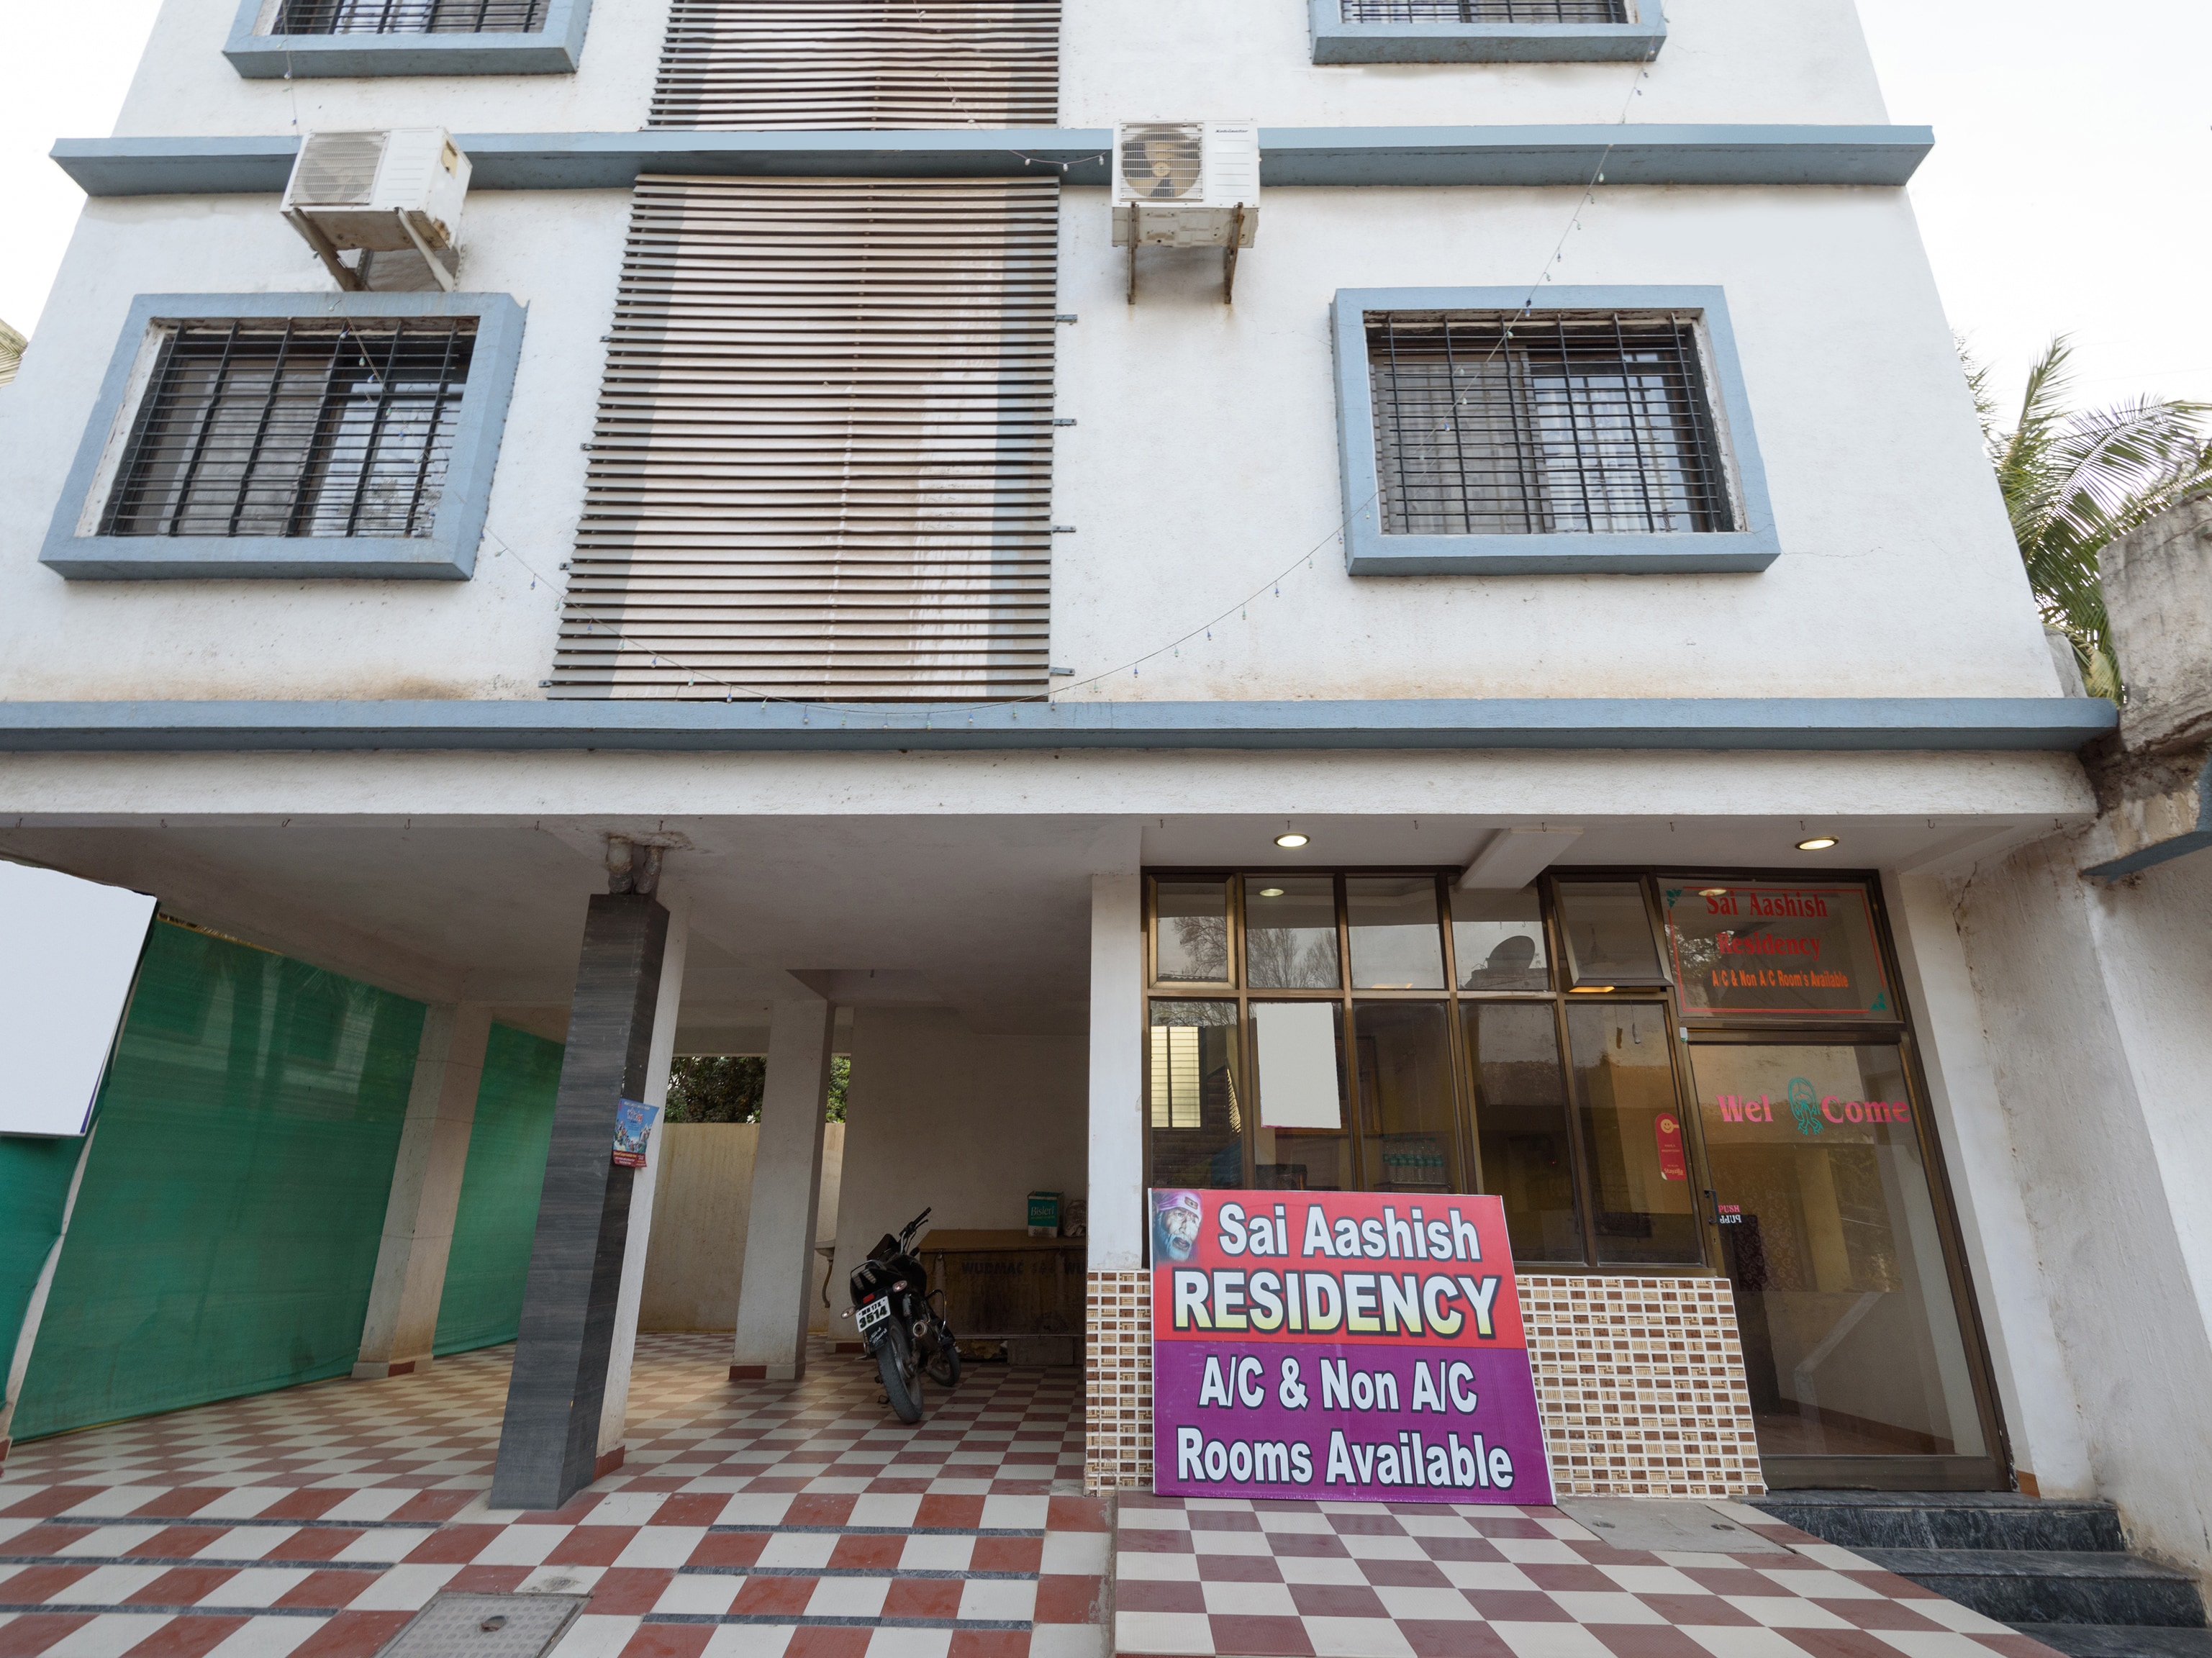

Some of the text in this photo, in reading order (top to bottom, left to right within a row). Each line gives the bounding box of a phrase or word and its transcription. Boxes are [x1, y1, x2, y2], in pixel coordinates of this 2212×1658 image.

[1706, 890, 1828, 918] Sai Aashish
[1716, 931, 1821, 961] Residency
[1712, 969, 1849, 988] A/C & Non A/C Room's Available
[1715, 1095, 1910, 1123] Wel Come
[1030, 1205, 1055, 1216] Bisleri
[1218, 1202, 1482, 1262] Sai Aashish
[859, 1305, 887, 1328] 3514
[1171, 1268, 1502, 1339] RESIDENCY
[1198, 1354, 1479, 1415] A/C & Non A/C
[1176, 1426, 1515, 1490] Rooms Available
